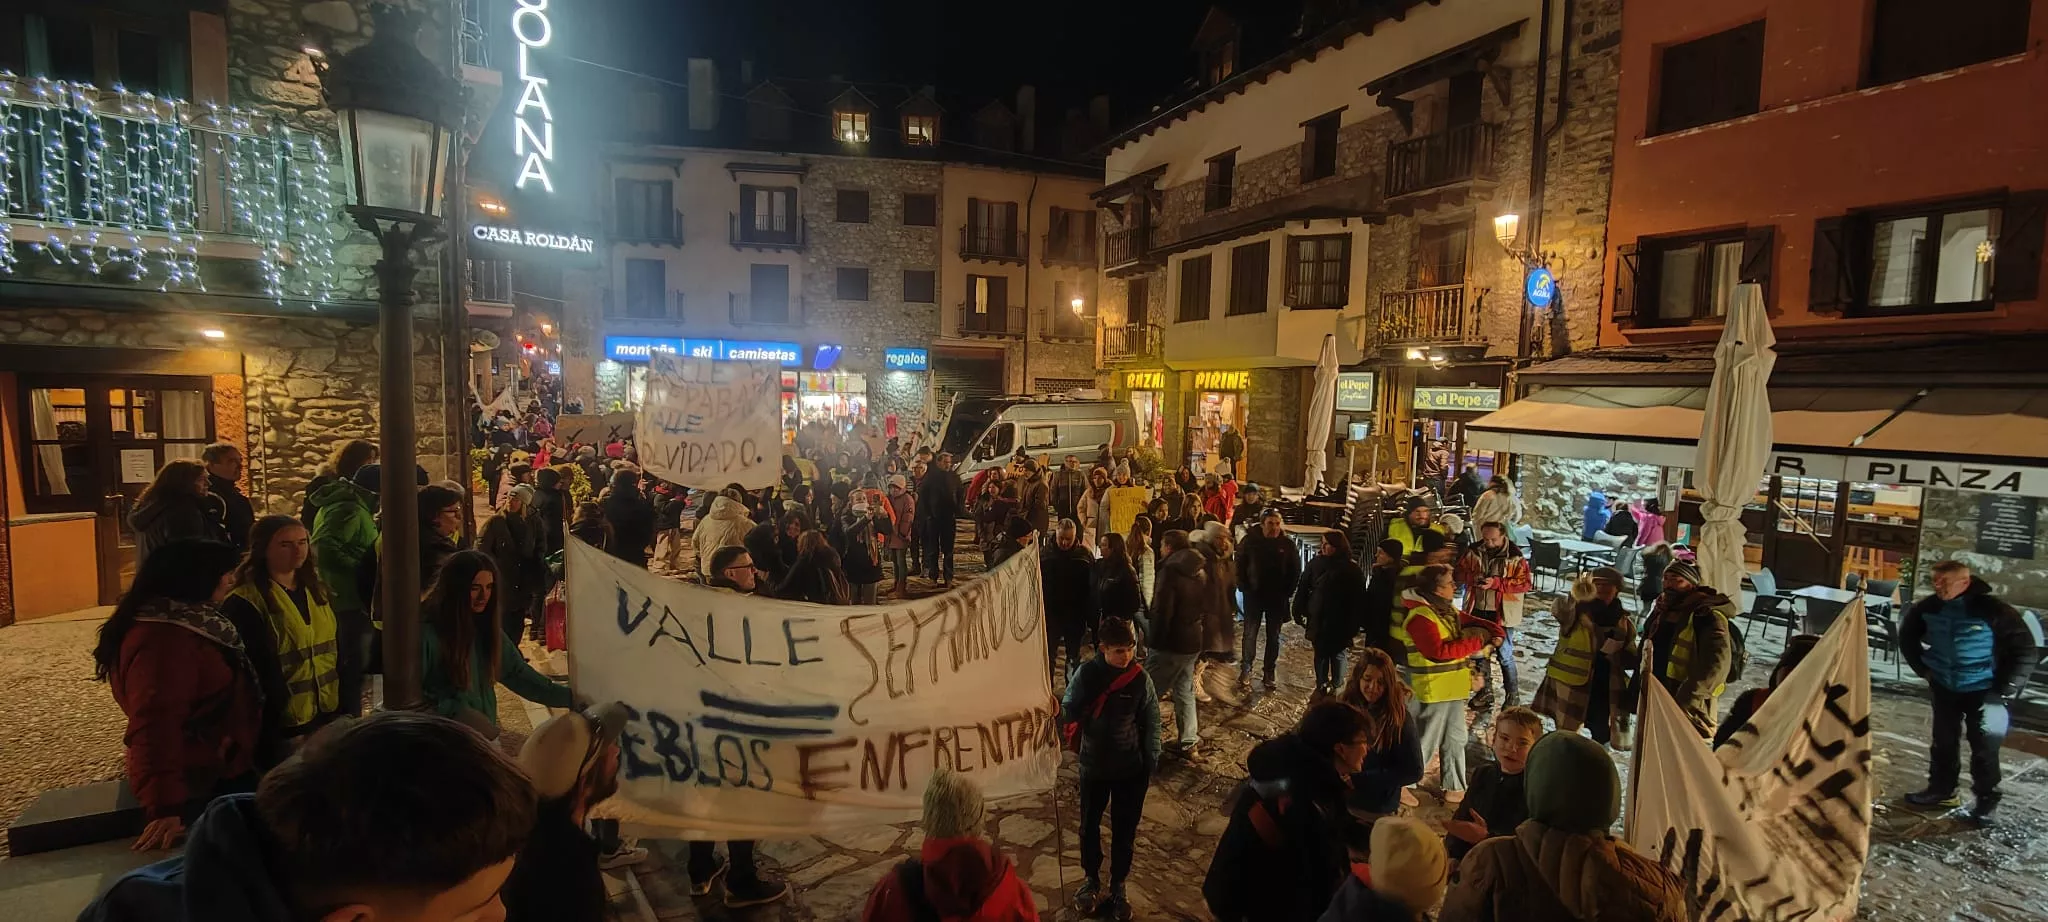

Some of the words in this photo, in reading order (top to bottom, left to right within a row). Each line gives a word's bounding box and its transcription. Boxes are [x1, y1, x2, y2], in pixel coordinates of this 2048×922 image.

[512, 0, 554, 193] OLANA
[473, 225, 522, 245] CASA
[525, 231, 594, 254] ROLDÁN
[692, 346, 713, 358] ski
[729, 349, 797, 361] camisetas
[886, 352, 926, 366] regalos
[1127, 372, 1165, 389] BAZA
[1195, 371, 1250, 389] PIRINE
[1349, 379, 1369, 391] Pepe
[1436, 393, 1447, 405] el
[1449, 393, 1482, 408] Pepe
[1867, 462, 2022, 493] PLAZA
[616, 582, 824, 667] VALLE
[618, 704, 774, 792] EBLOS
